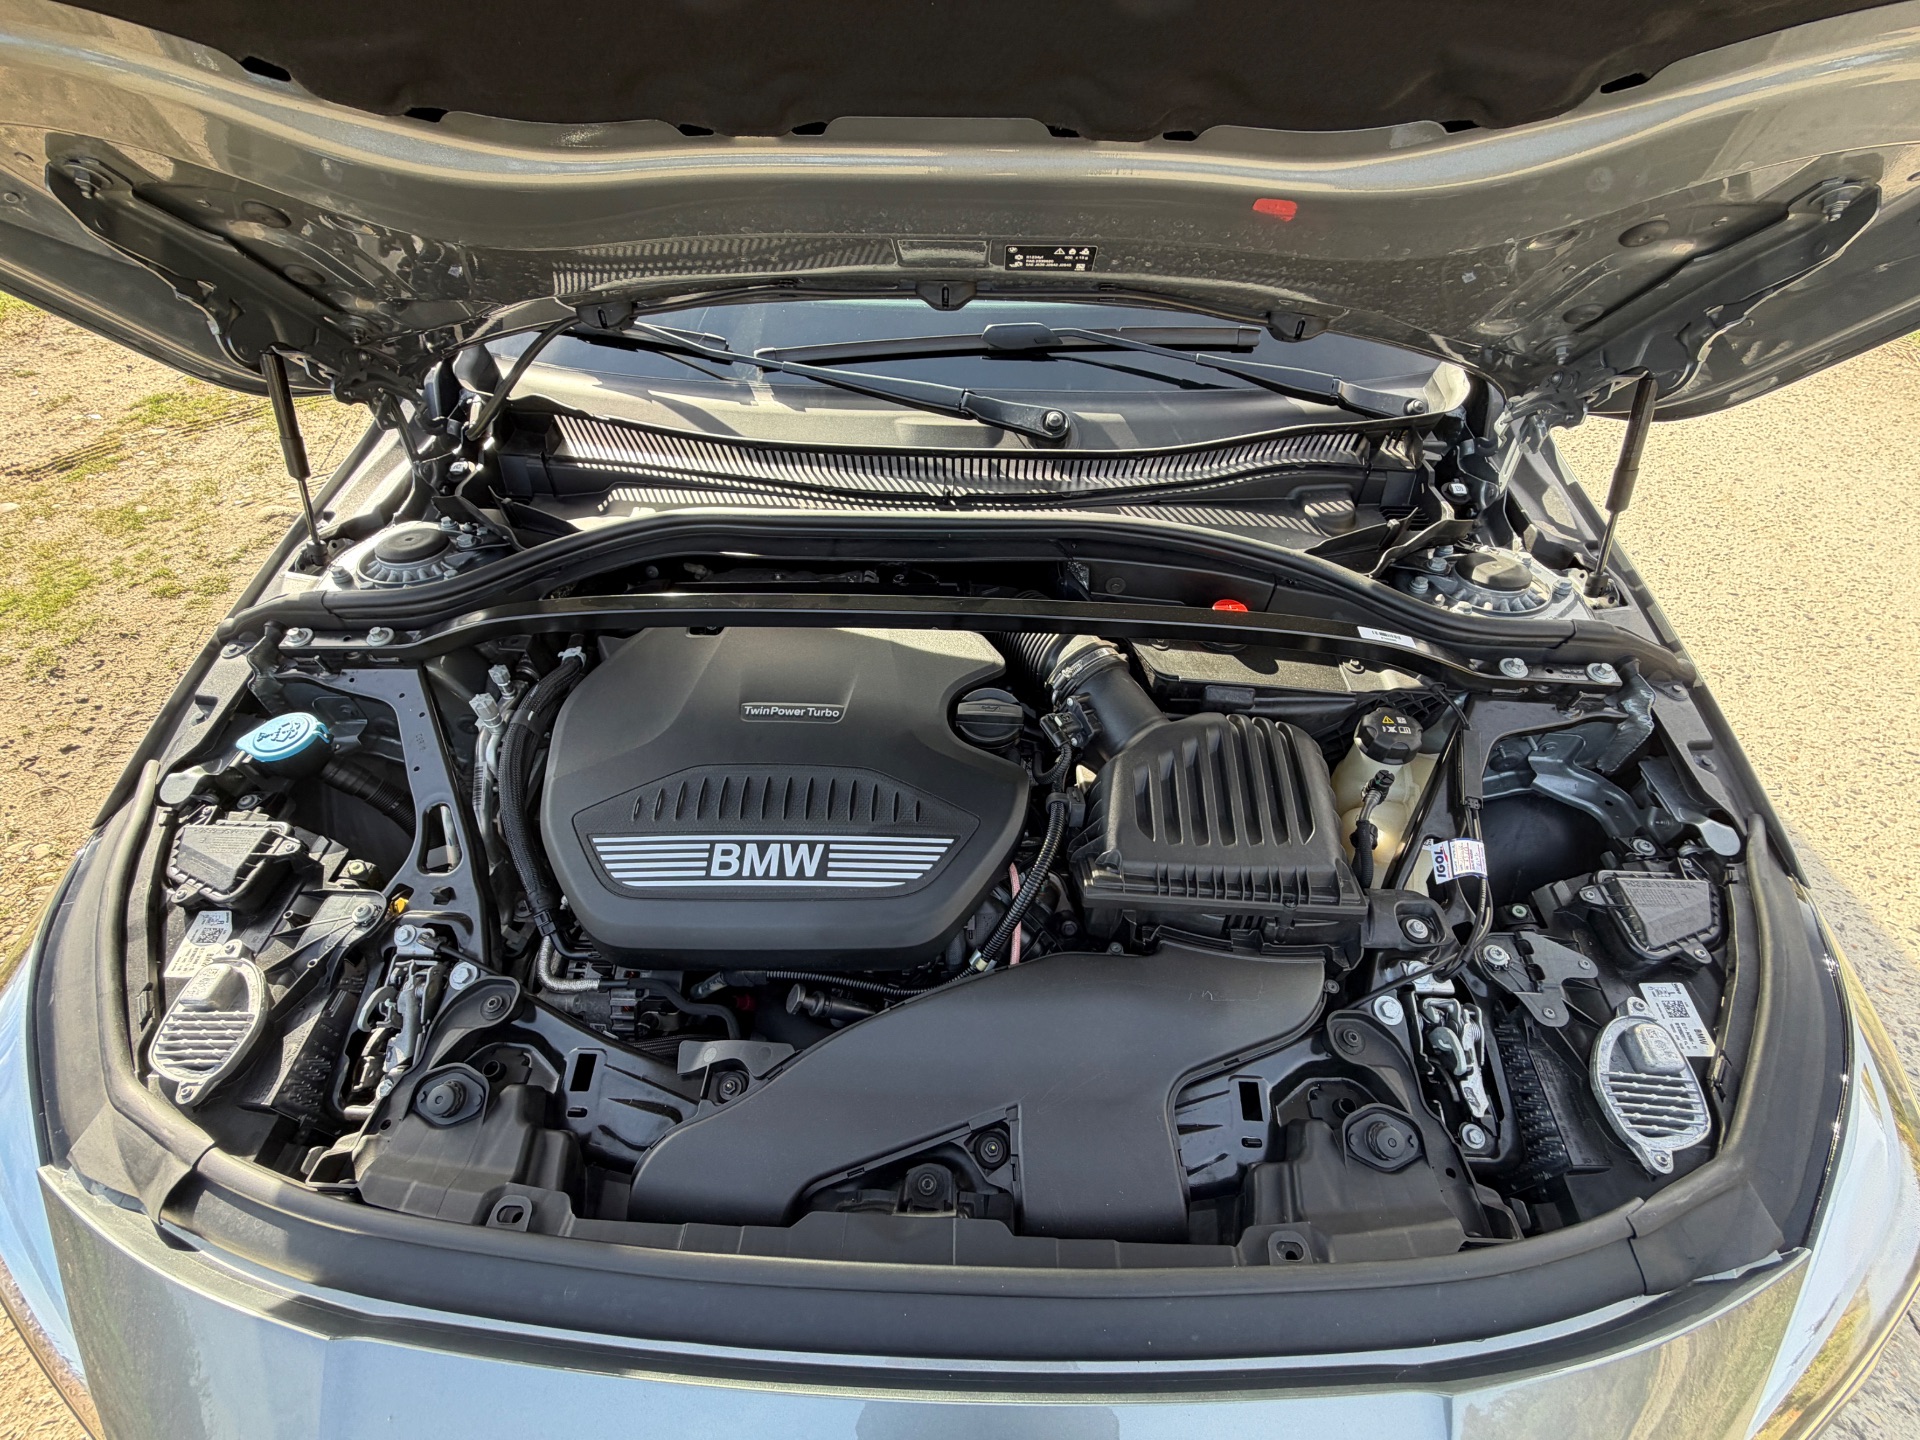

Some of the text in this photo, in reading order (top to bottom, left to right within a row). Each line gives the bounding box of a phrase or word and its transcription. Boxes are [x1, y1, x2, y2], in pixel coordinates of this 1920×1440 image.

[807, 707, 840, 717] Turbo
[710, 843, 825, 877] BMW
[1434, 851, 1447, 878] IGOL
[1694, 1028, 1709, 1046] BMW
